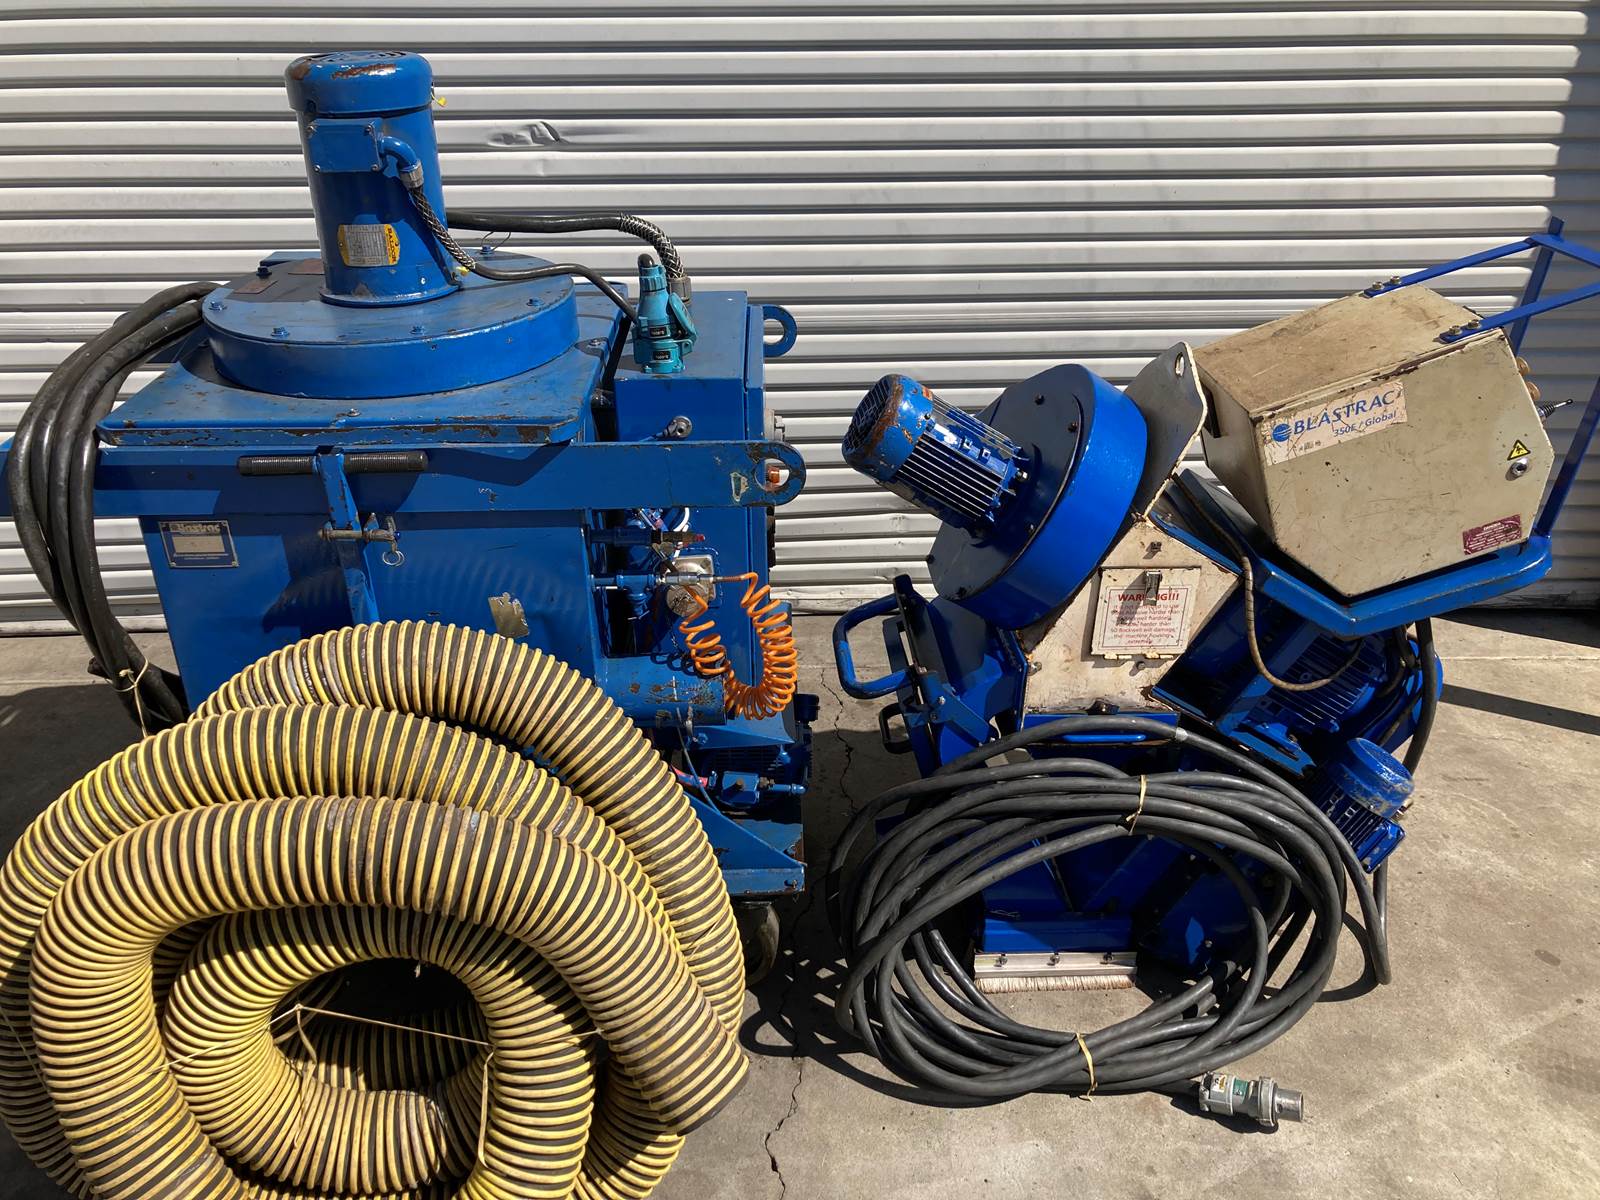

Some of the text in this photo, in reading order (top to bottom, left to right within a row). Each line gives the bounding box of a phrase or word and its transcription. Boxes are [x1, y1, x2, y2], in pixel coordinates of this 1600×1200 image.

[387, 228, 397, 264] BALDOR
[1293, 390, 1396, 435] BLASTRAC
[1365, 410, 1397, 427] Global
[1118, 593, 1180, 602] WARG!!!
